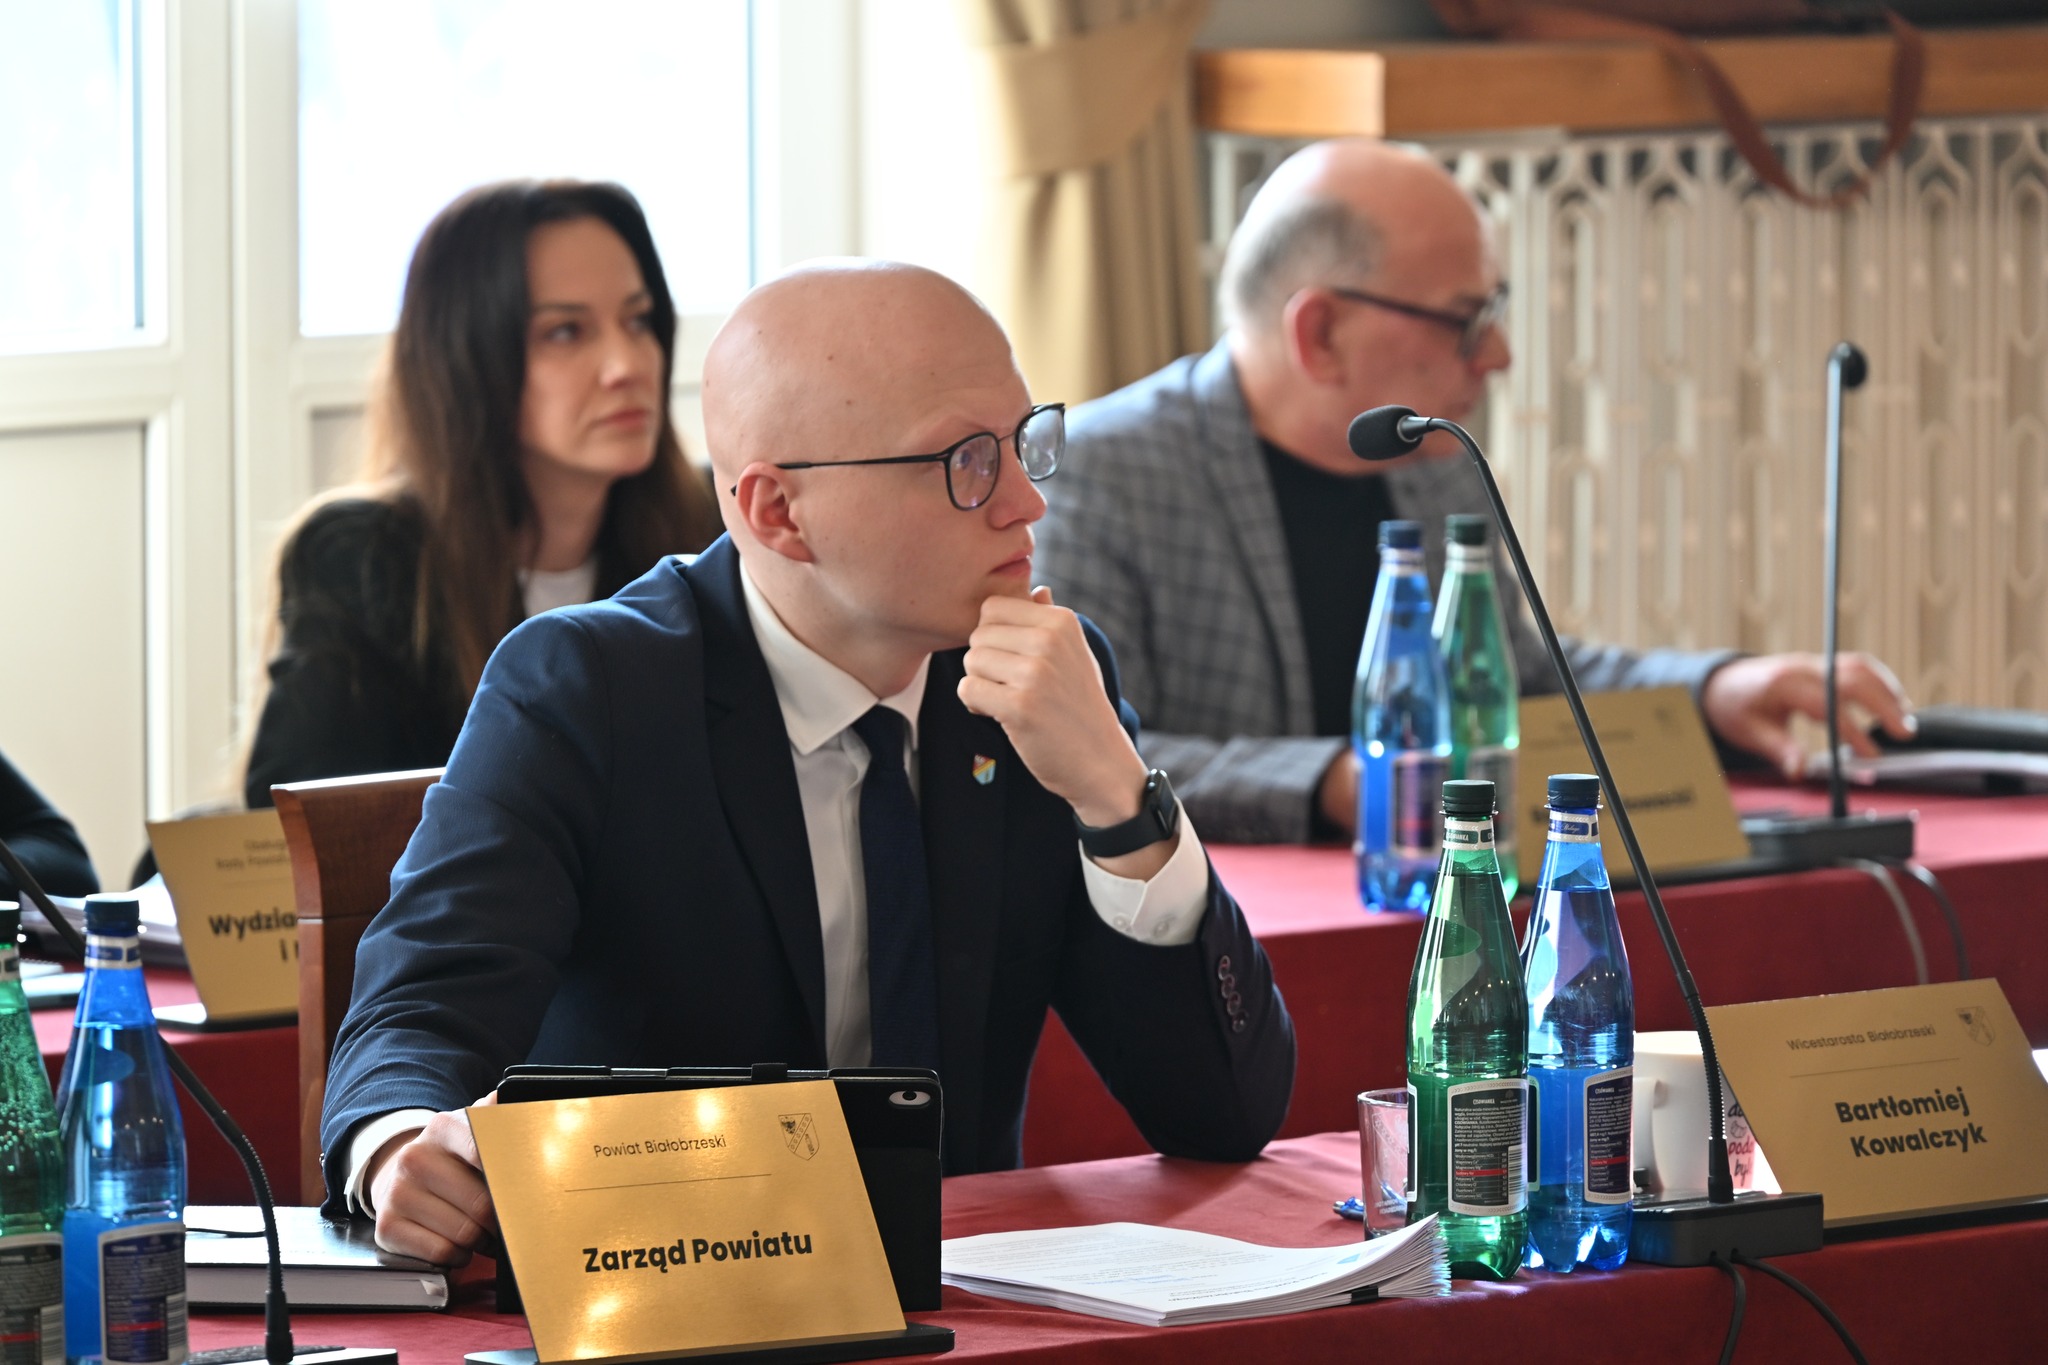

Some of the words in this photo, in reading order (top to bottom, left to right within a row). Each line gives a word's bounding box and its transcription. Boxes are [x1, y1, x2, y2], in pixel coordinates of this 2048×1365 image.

[208, 907, 297, 940] Wydzia
[1786, 1033, 1865, 1050] Wicestarosta
[1867, 1024, 1936, 1042] Białobrzeski
[1835, 1086, 1970, 1124] Bartłomiej
[593, 1141, 642, 1158] Powiat
[644, 1135, 727, 1155] Białobrzeski
[1850, 1122, 1988, 1157] Kowalczyk
[582, 1239, 686, 1274] Zarząd
[693, 1230, 813, 1266] Powiatu
